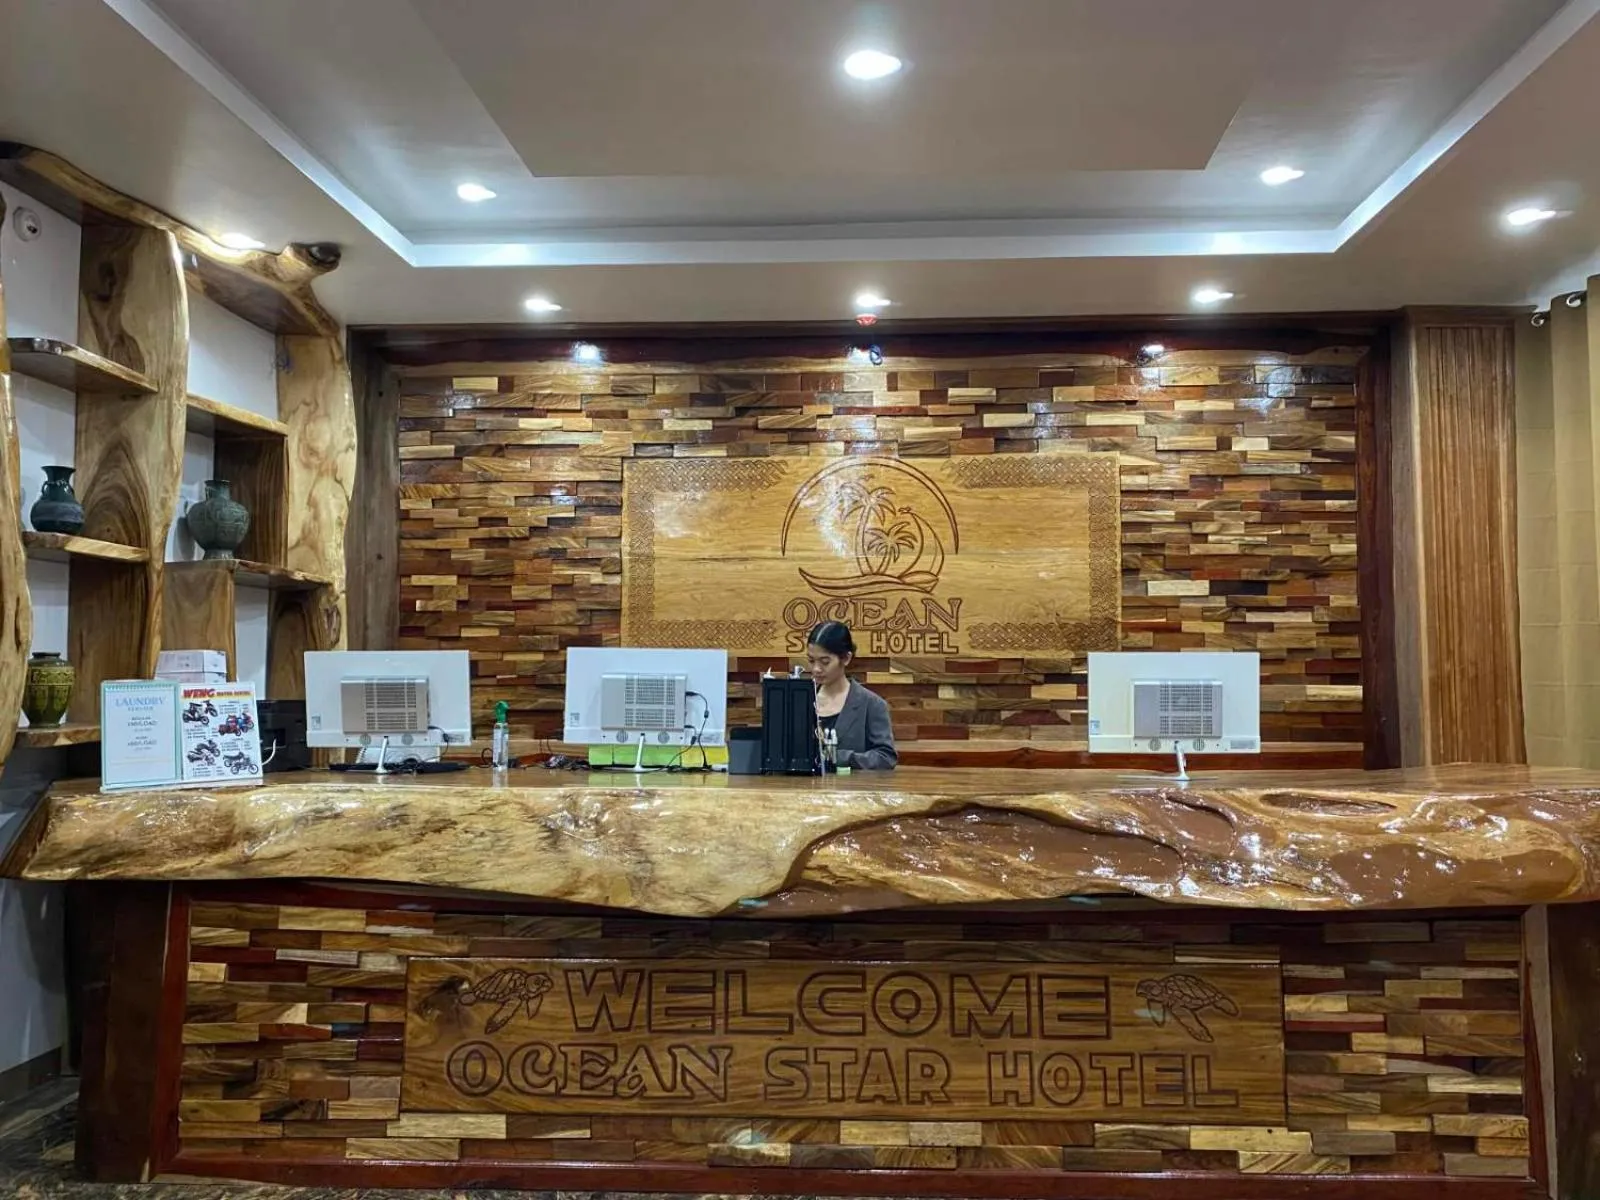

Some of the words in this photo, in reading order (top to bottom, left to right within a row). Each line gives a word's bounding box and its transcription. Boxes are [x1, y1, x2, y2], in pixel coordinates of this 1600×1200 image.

[783, 597, 962, 632] OCEAN
[870, 631, 960, 655] HOTEL
[116, 696, 167, 706] LAUNDRY
[563, 968, 1112, 1041] WELCOME
[446, 1040, 733, 1101] OCEAN
[763, 1046, 952, 1106] STAR
[988, 1050, 1240, 1109] HOTEL
